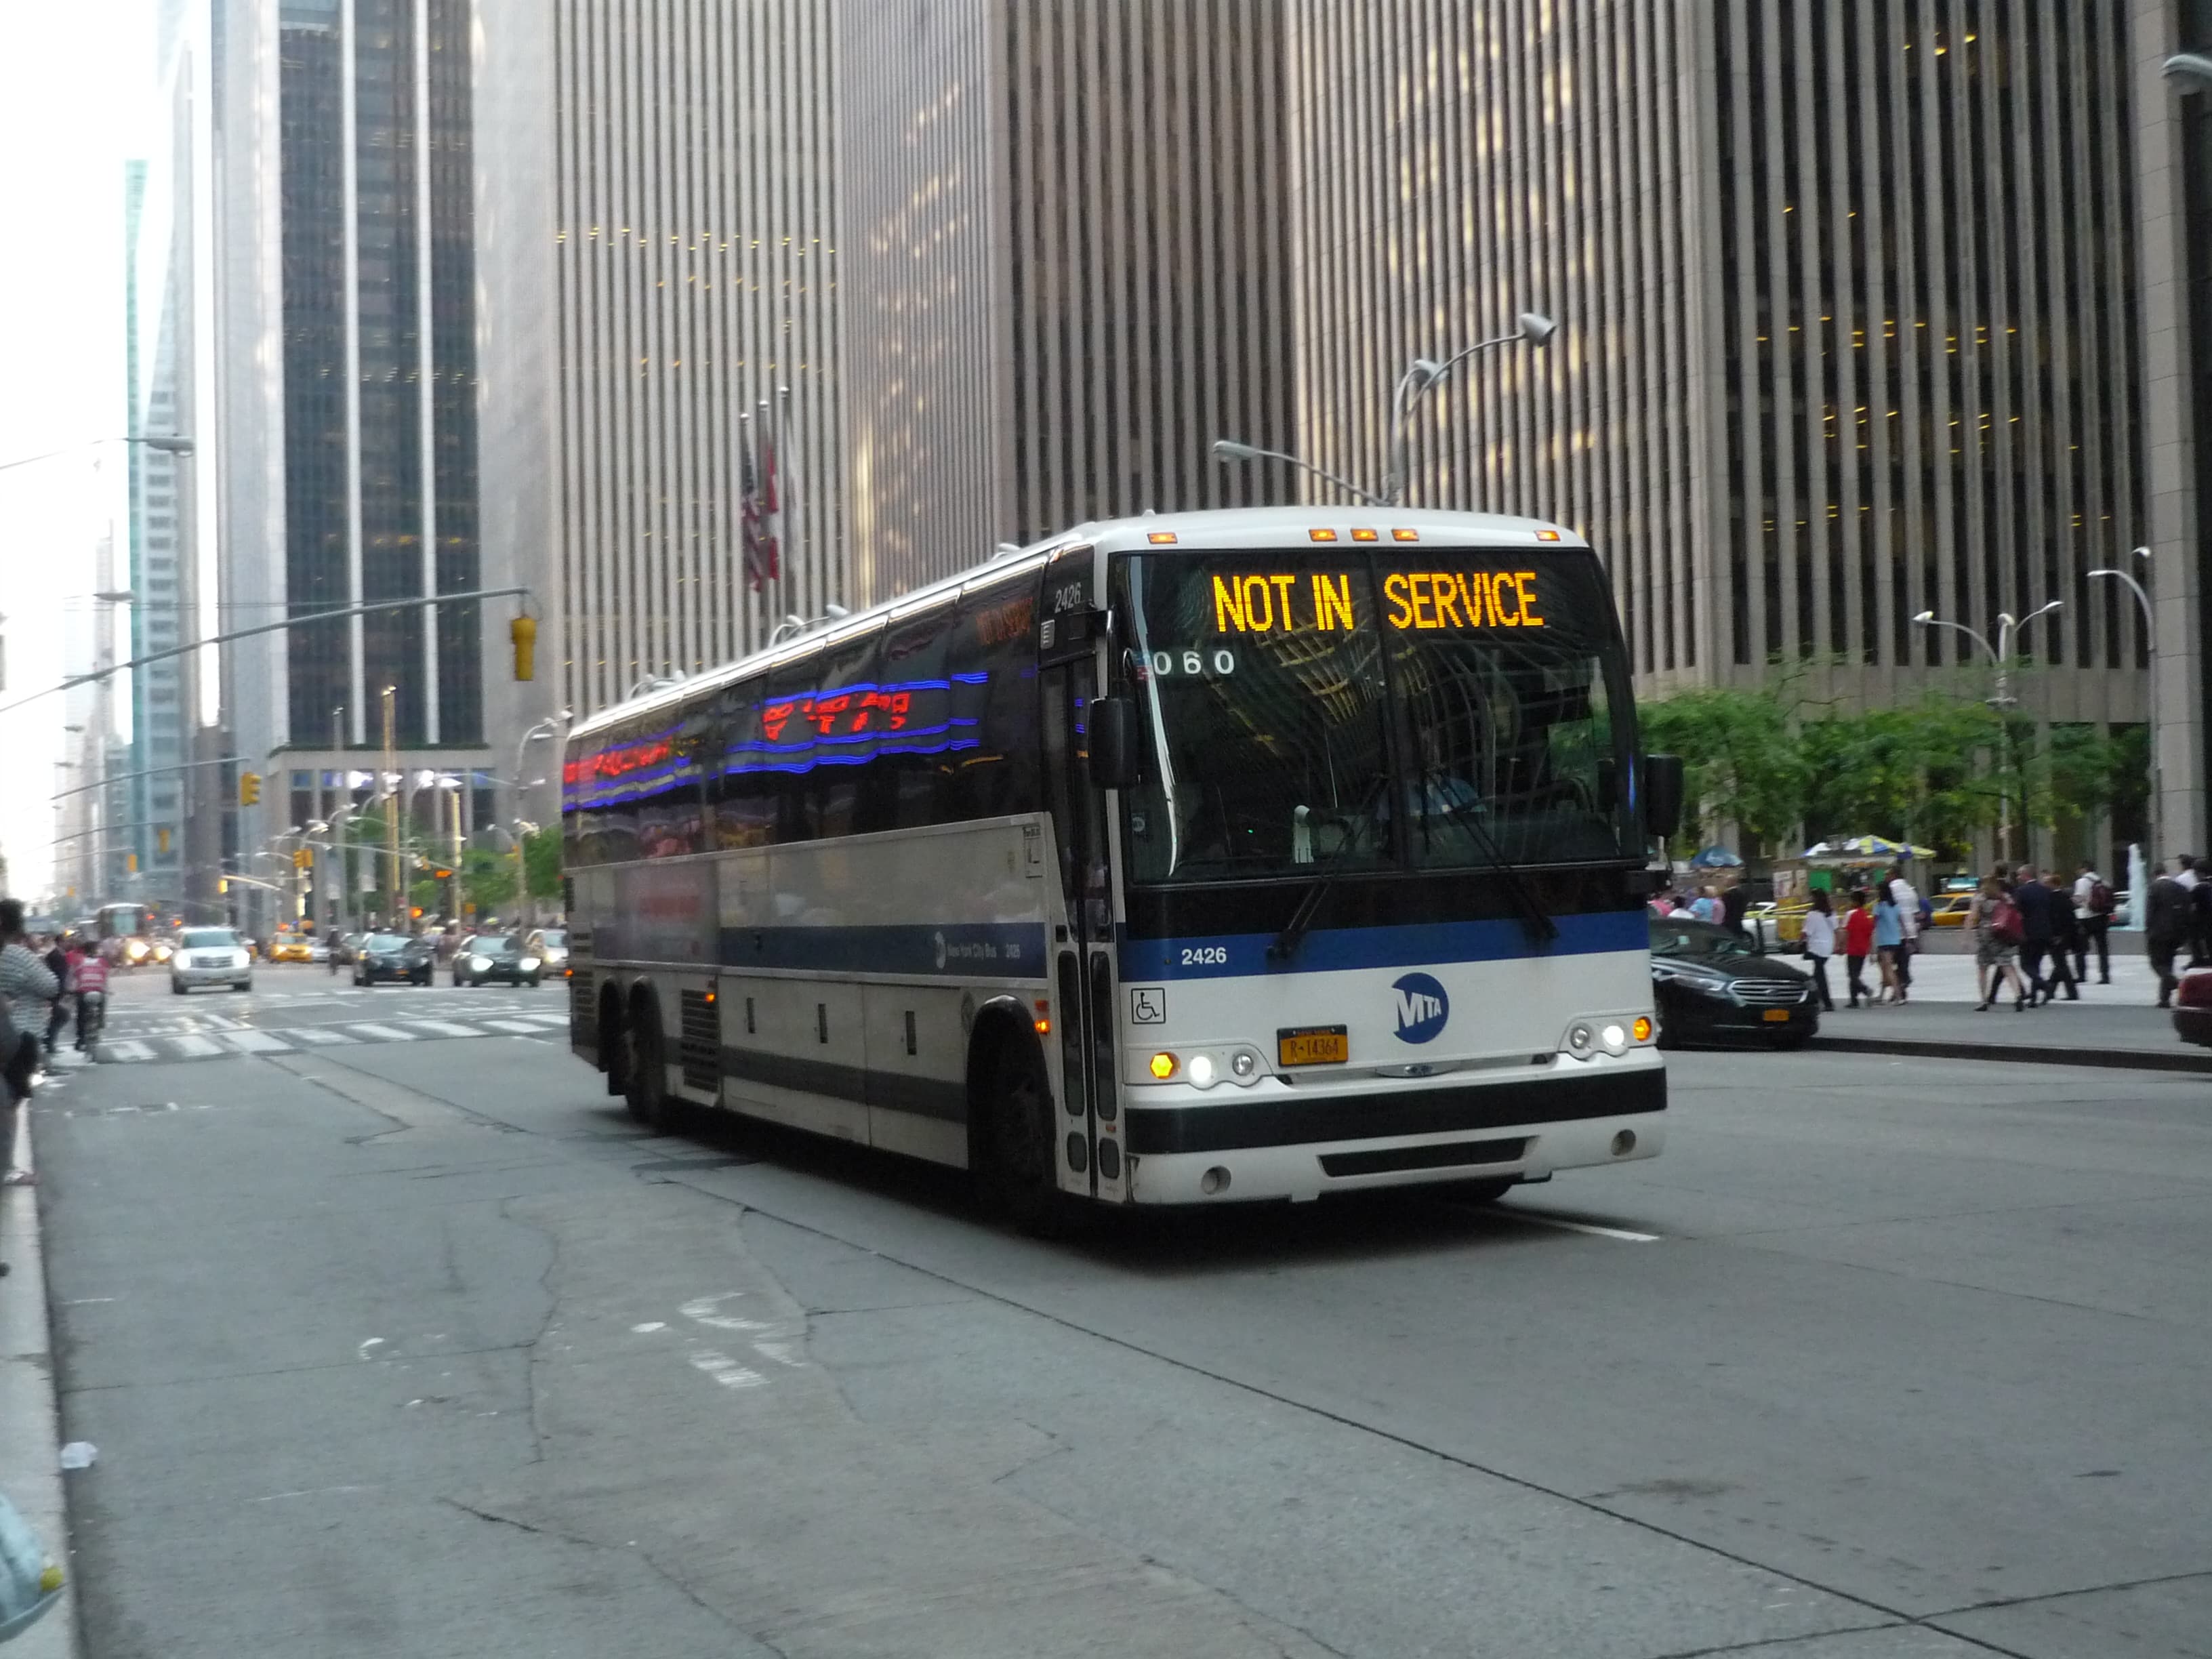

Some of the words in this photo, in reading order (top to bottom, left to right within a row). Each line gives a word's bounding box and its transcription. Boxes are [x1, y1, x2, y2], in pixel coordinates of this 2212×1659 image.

[1054, 581, 1082, 613] 2426
[1213, 575, 1295, 632] NOT
[1311, 574, 1354, 632] IN
[1384, 571, 1544, 630] SERVICE
[1181, 946, 1227, 966] 2426
[1391, 986, 1443, 1032] MTA
